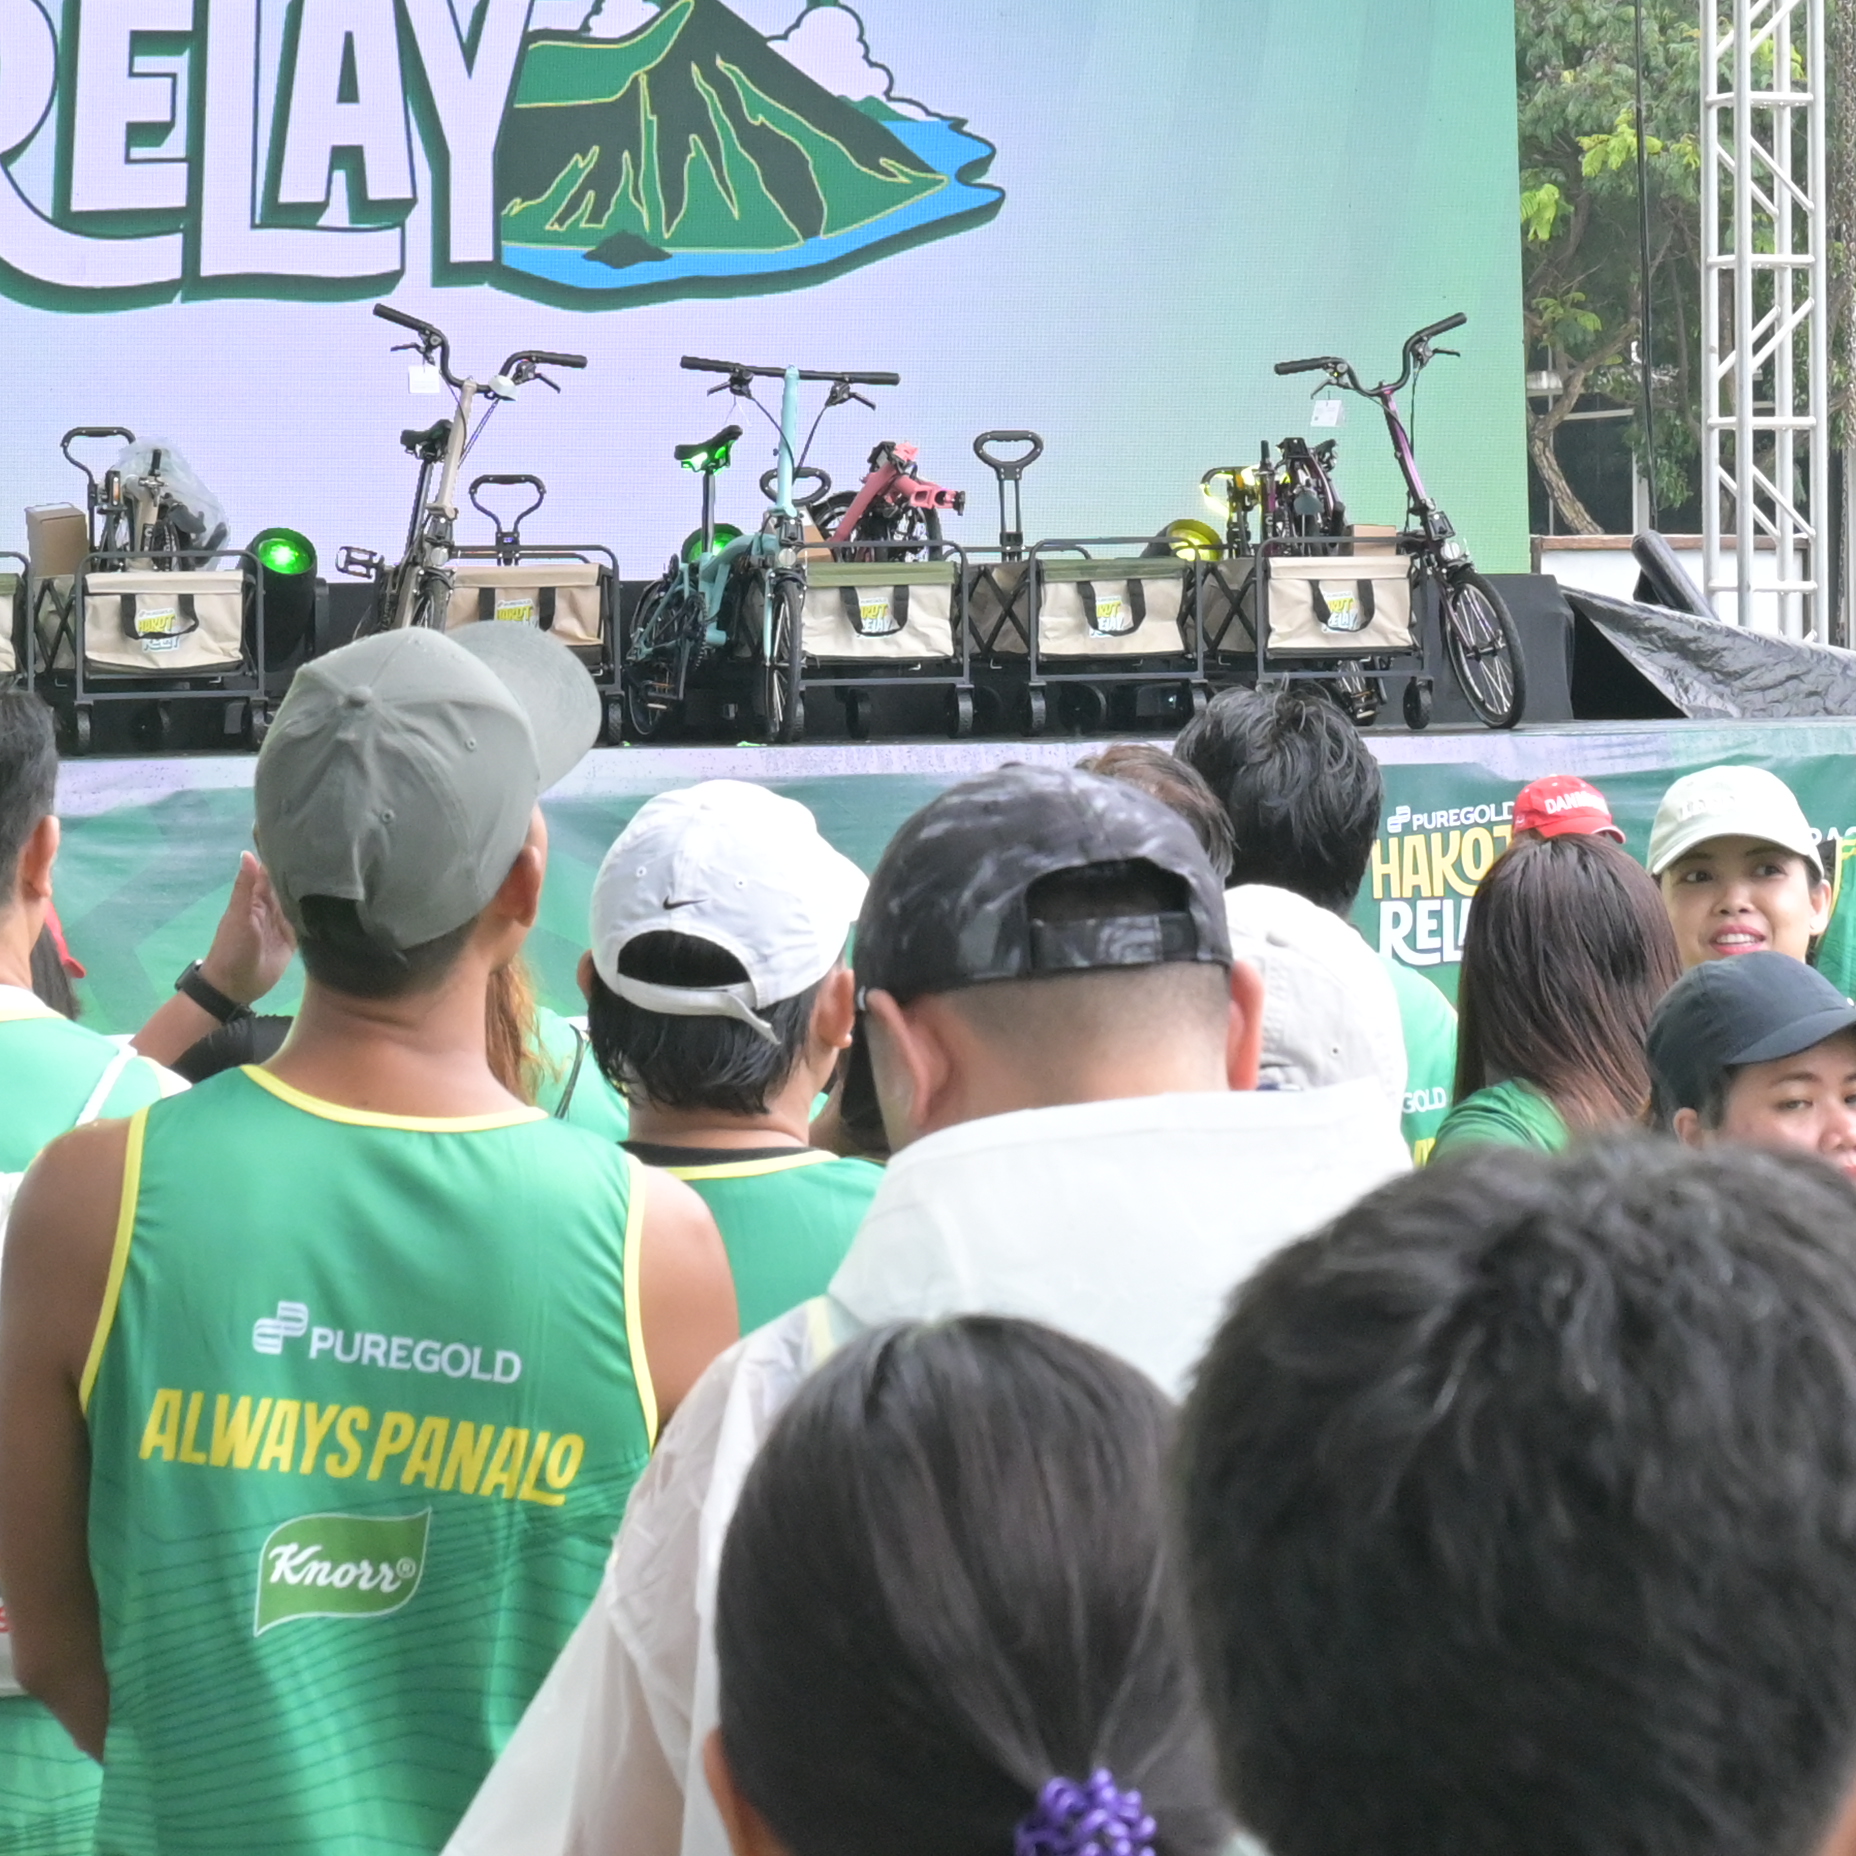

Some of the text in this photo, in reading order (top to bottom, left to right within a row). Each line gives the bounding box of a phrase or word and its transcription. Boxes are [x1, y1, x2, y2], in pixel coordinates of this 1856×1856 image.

[308, 1326, 522, 1385] PUREGOLD
[138, 1388, 586, 1507] ALWAYS PANALO
